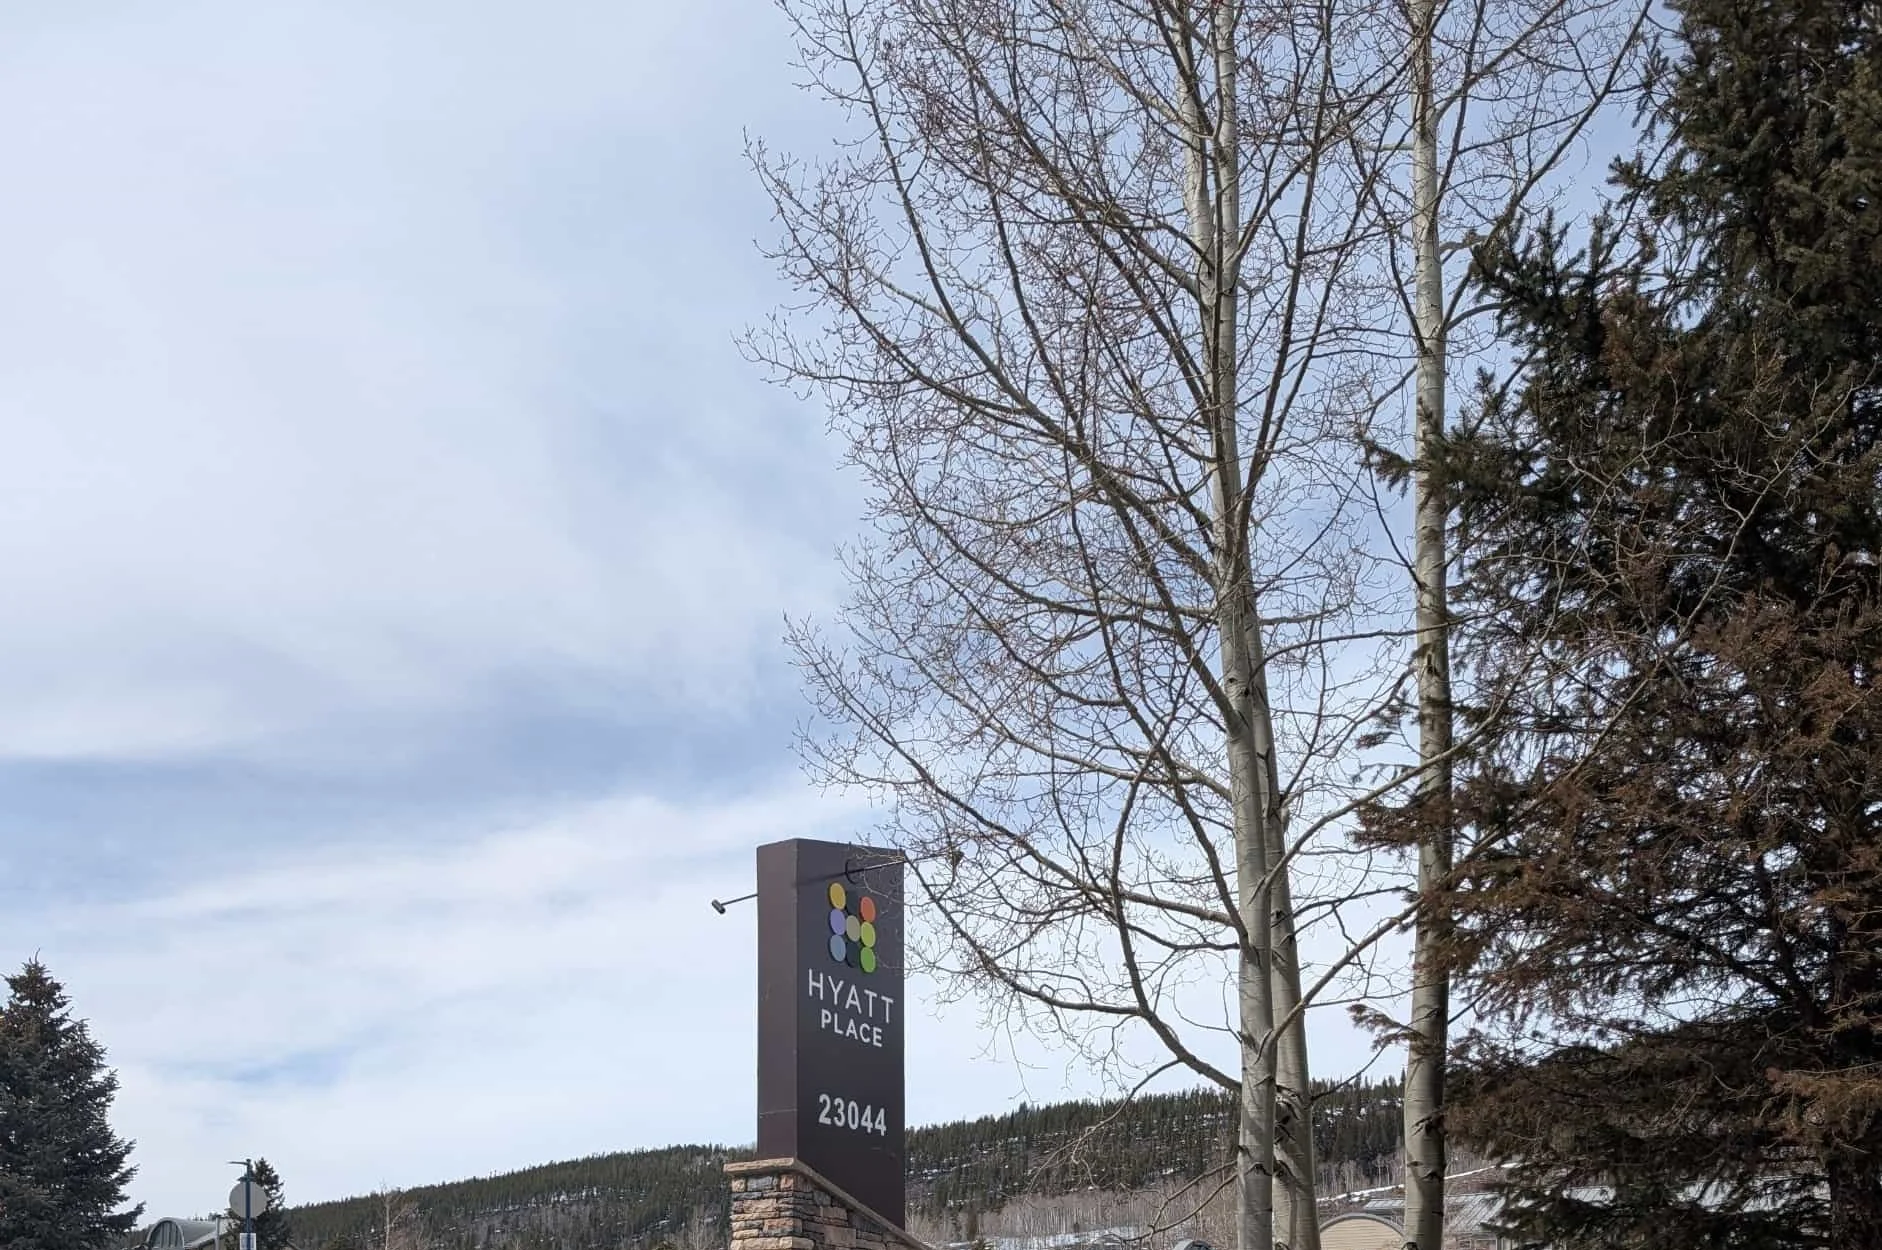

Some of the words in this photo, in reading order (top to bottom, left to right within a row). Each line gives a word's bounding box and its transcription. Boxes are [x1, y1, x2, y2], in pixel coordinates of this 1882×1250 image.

[808, 967, 894, 1024] HYATT
[821, 1008, 883, 1048] PLACE
[818, 1093, 887, 1137] 23044
